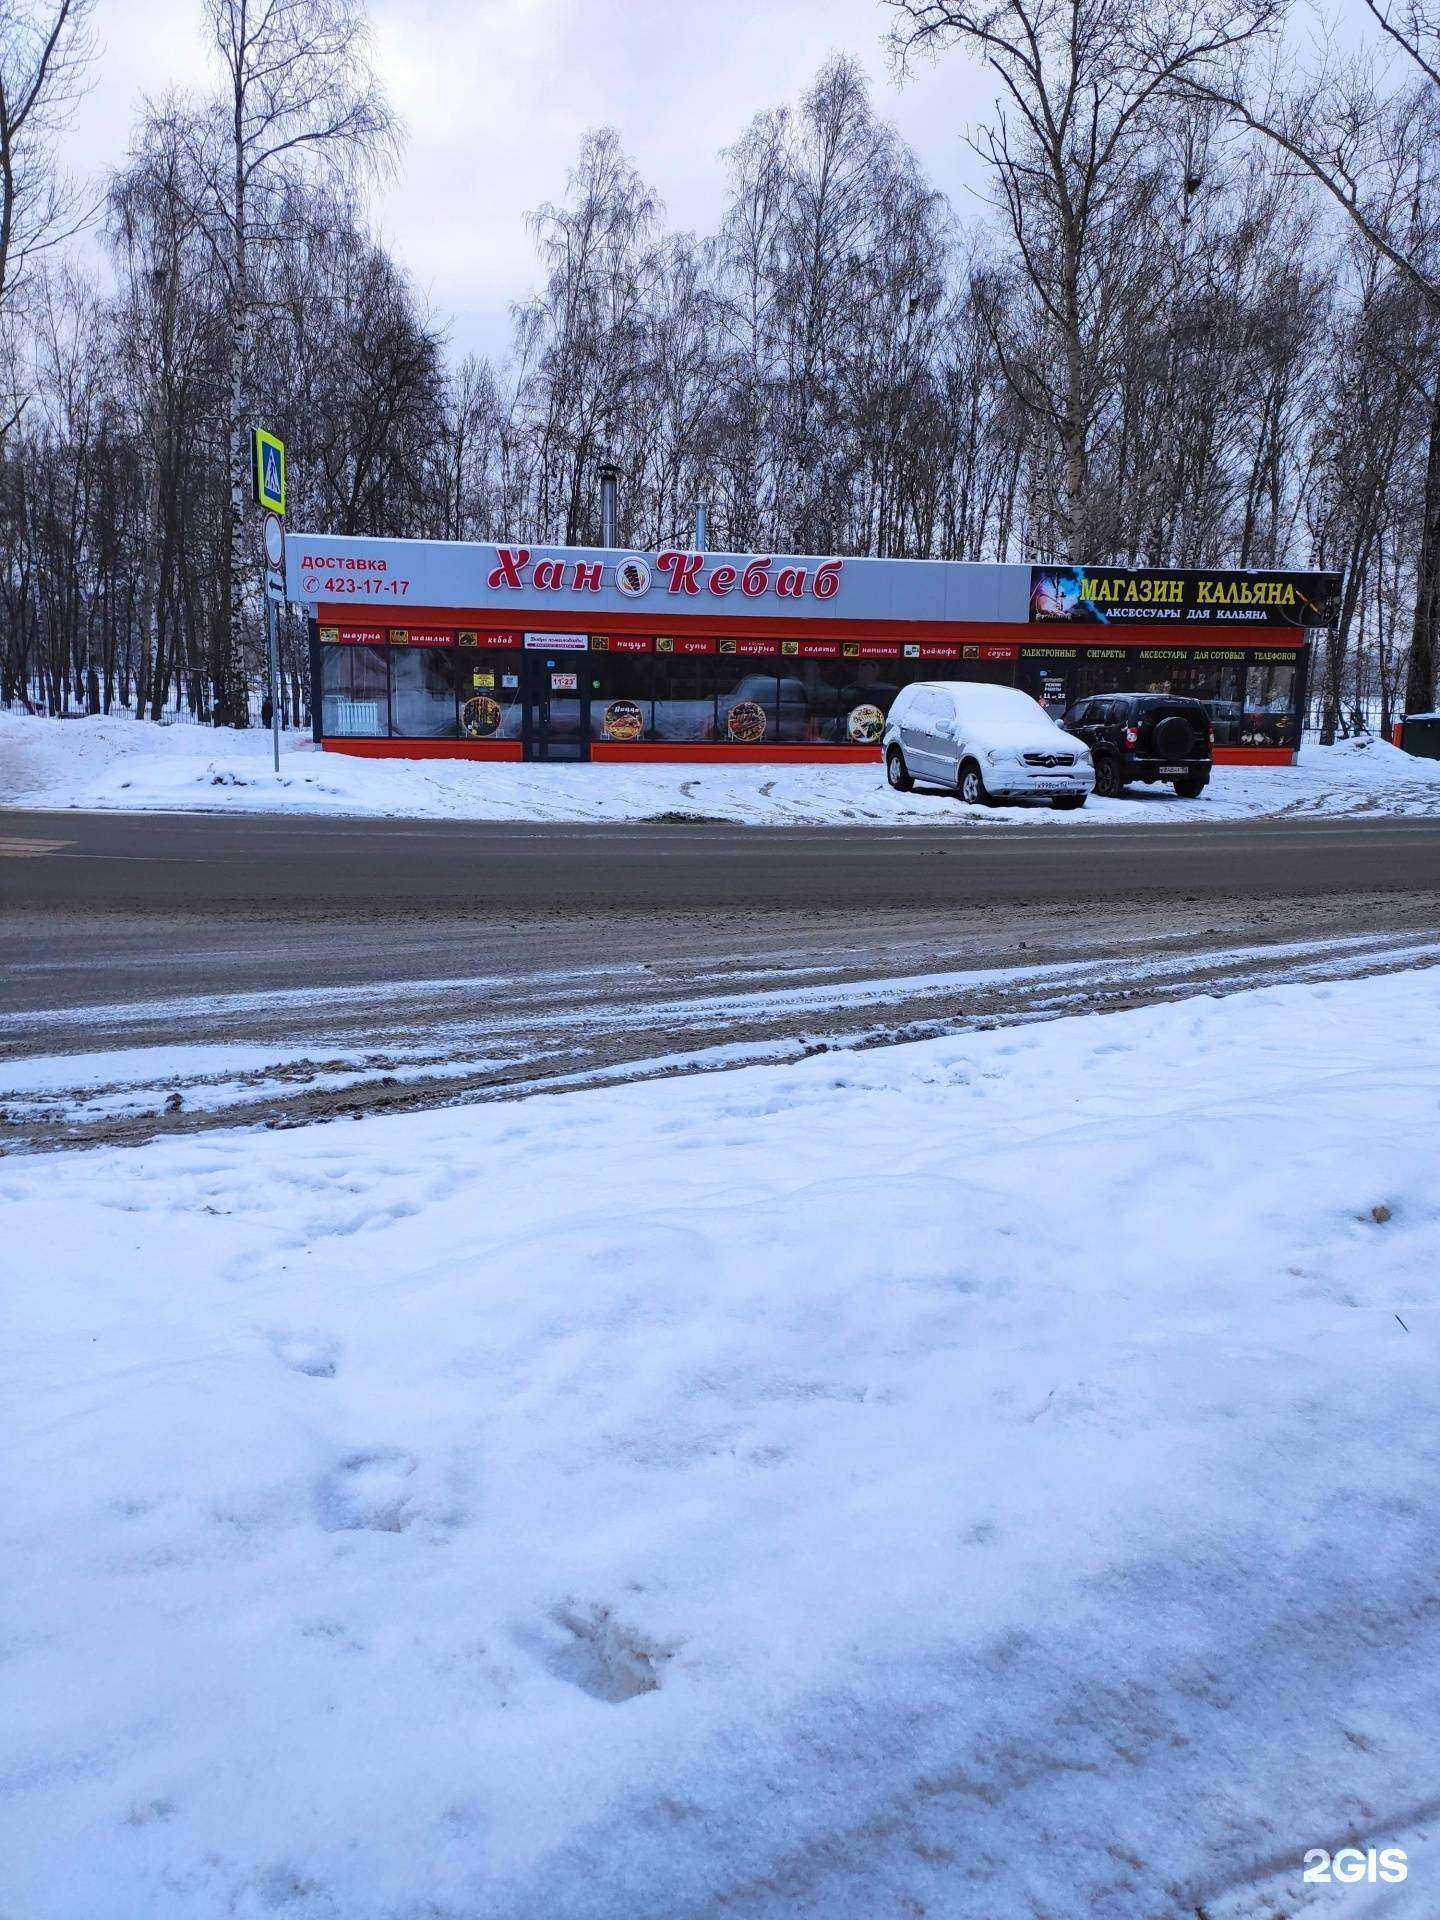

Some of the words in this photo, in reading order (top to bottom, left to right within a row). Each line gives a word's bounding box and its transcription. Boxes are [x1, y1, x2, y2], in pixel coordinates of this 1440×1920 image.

[301, 556, 387, 571] доставка
[487, 546, 604, 592] Хан
[656, 550, 844, 599] Кебаб
[324, 577, 410, 595] 423-17-17
[1079, 578, 1183, 603] МАГАЗИН
[1196, 581, 1296, 605] КАЛЬЯНА
[1105, 608, 1181, 618] АКСЕССУАРЫ
[1187, 609, 1210, 620] ДЛЯ
[1216, 609, 1268, 620] КАЛЬЯНА
[342, 631, 381, 642] шаурма
[411, 635, 451, 643] шашлык
[617, 640, 647, 650] пицца
[685, 642, 707, 651] супы
[740, 645, 775, 655] шаурма
[804, 645, 836, 653] салаты
[862, 646, 897, 655] напитки
[1021, 648, 1077, 658] ЭЛЕКТРОННЫЕ
[1087, 650, 1126, 659] СИГАРЕТЫ
[1139, 651, 1187, 660] АКСЕССУАРЫ
[1194, 651, 1209, 660] ДЛЯ
[1210, 651, 1245, 660] СОТОВЫХ
[1254, 651, 1297, 661] ТЕЛЕФОНОВ
